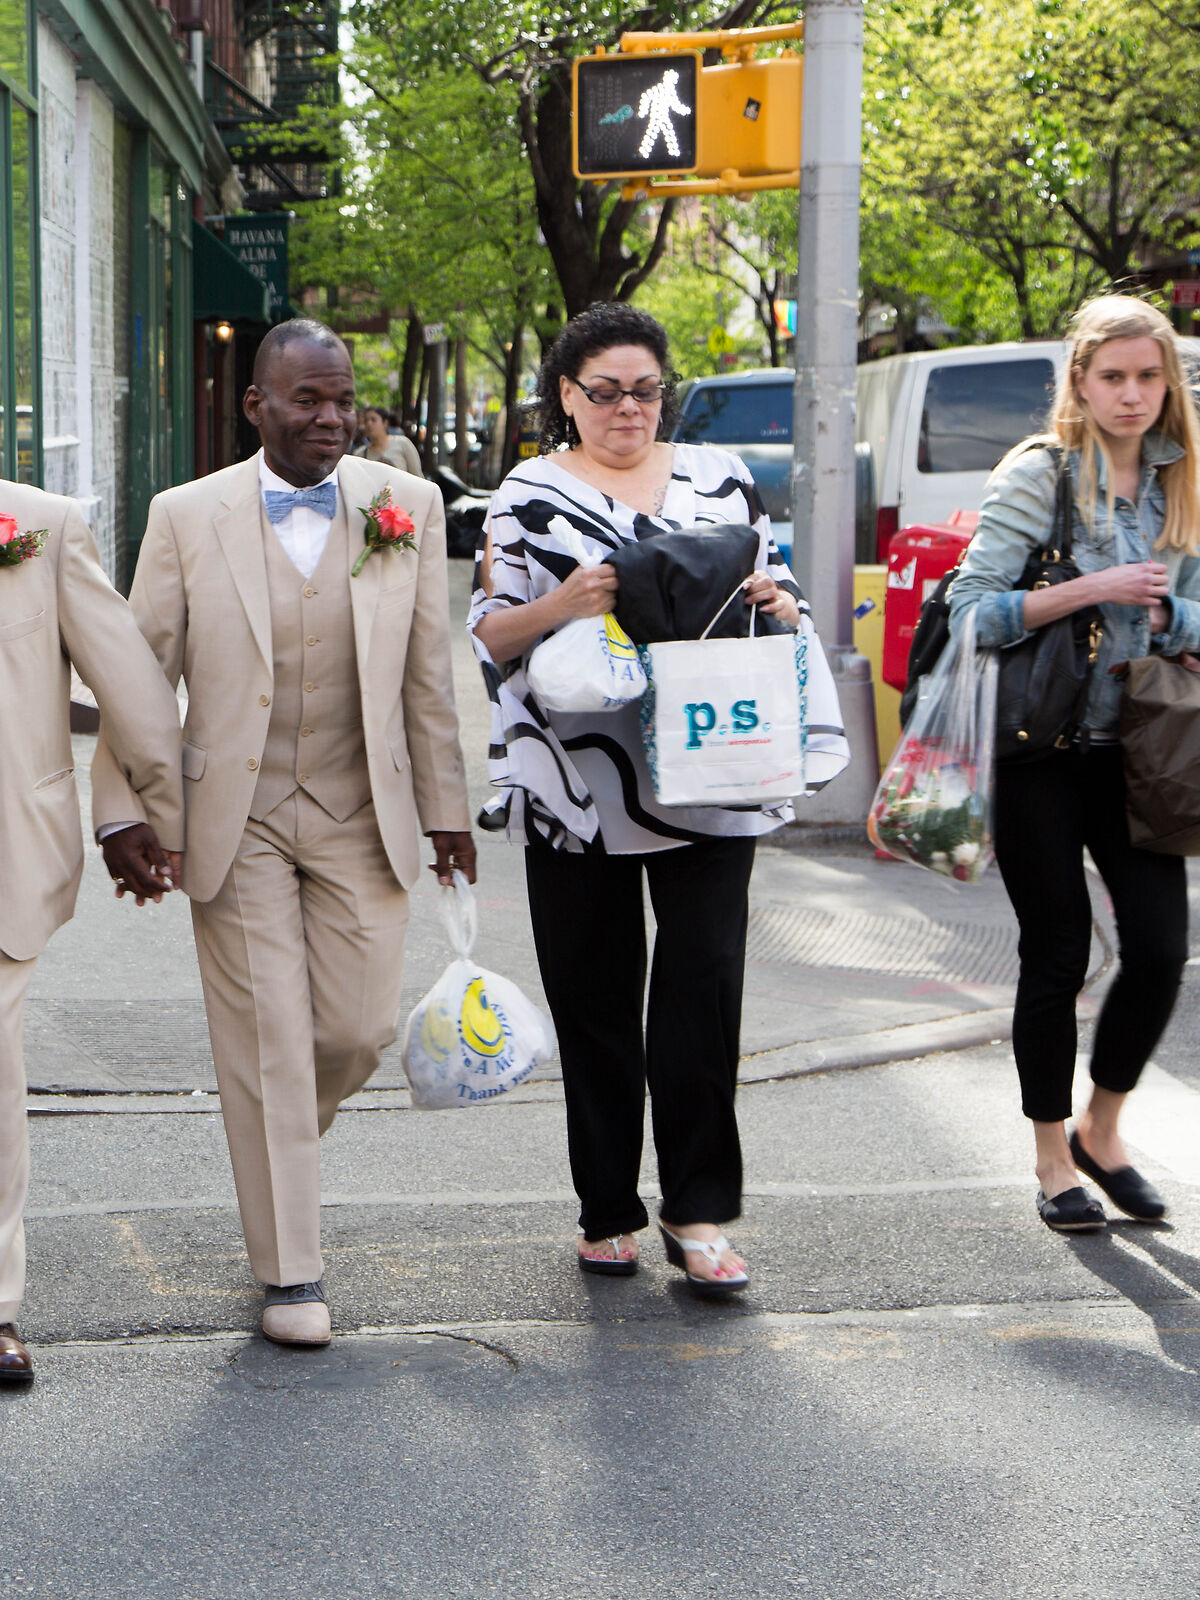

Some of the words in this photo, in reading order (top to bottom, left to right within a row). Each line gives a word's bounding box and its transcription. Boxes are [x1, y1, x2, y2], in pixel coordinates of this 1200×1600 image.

[229, 228, 285, 244] HAVANA
[239, 246, 277, 262] ALMA
[457, 1083, 508, 1100] Thank
